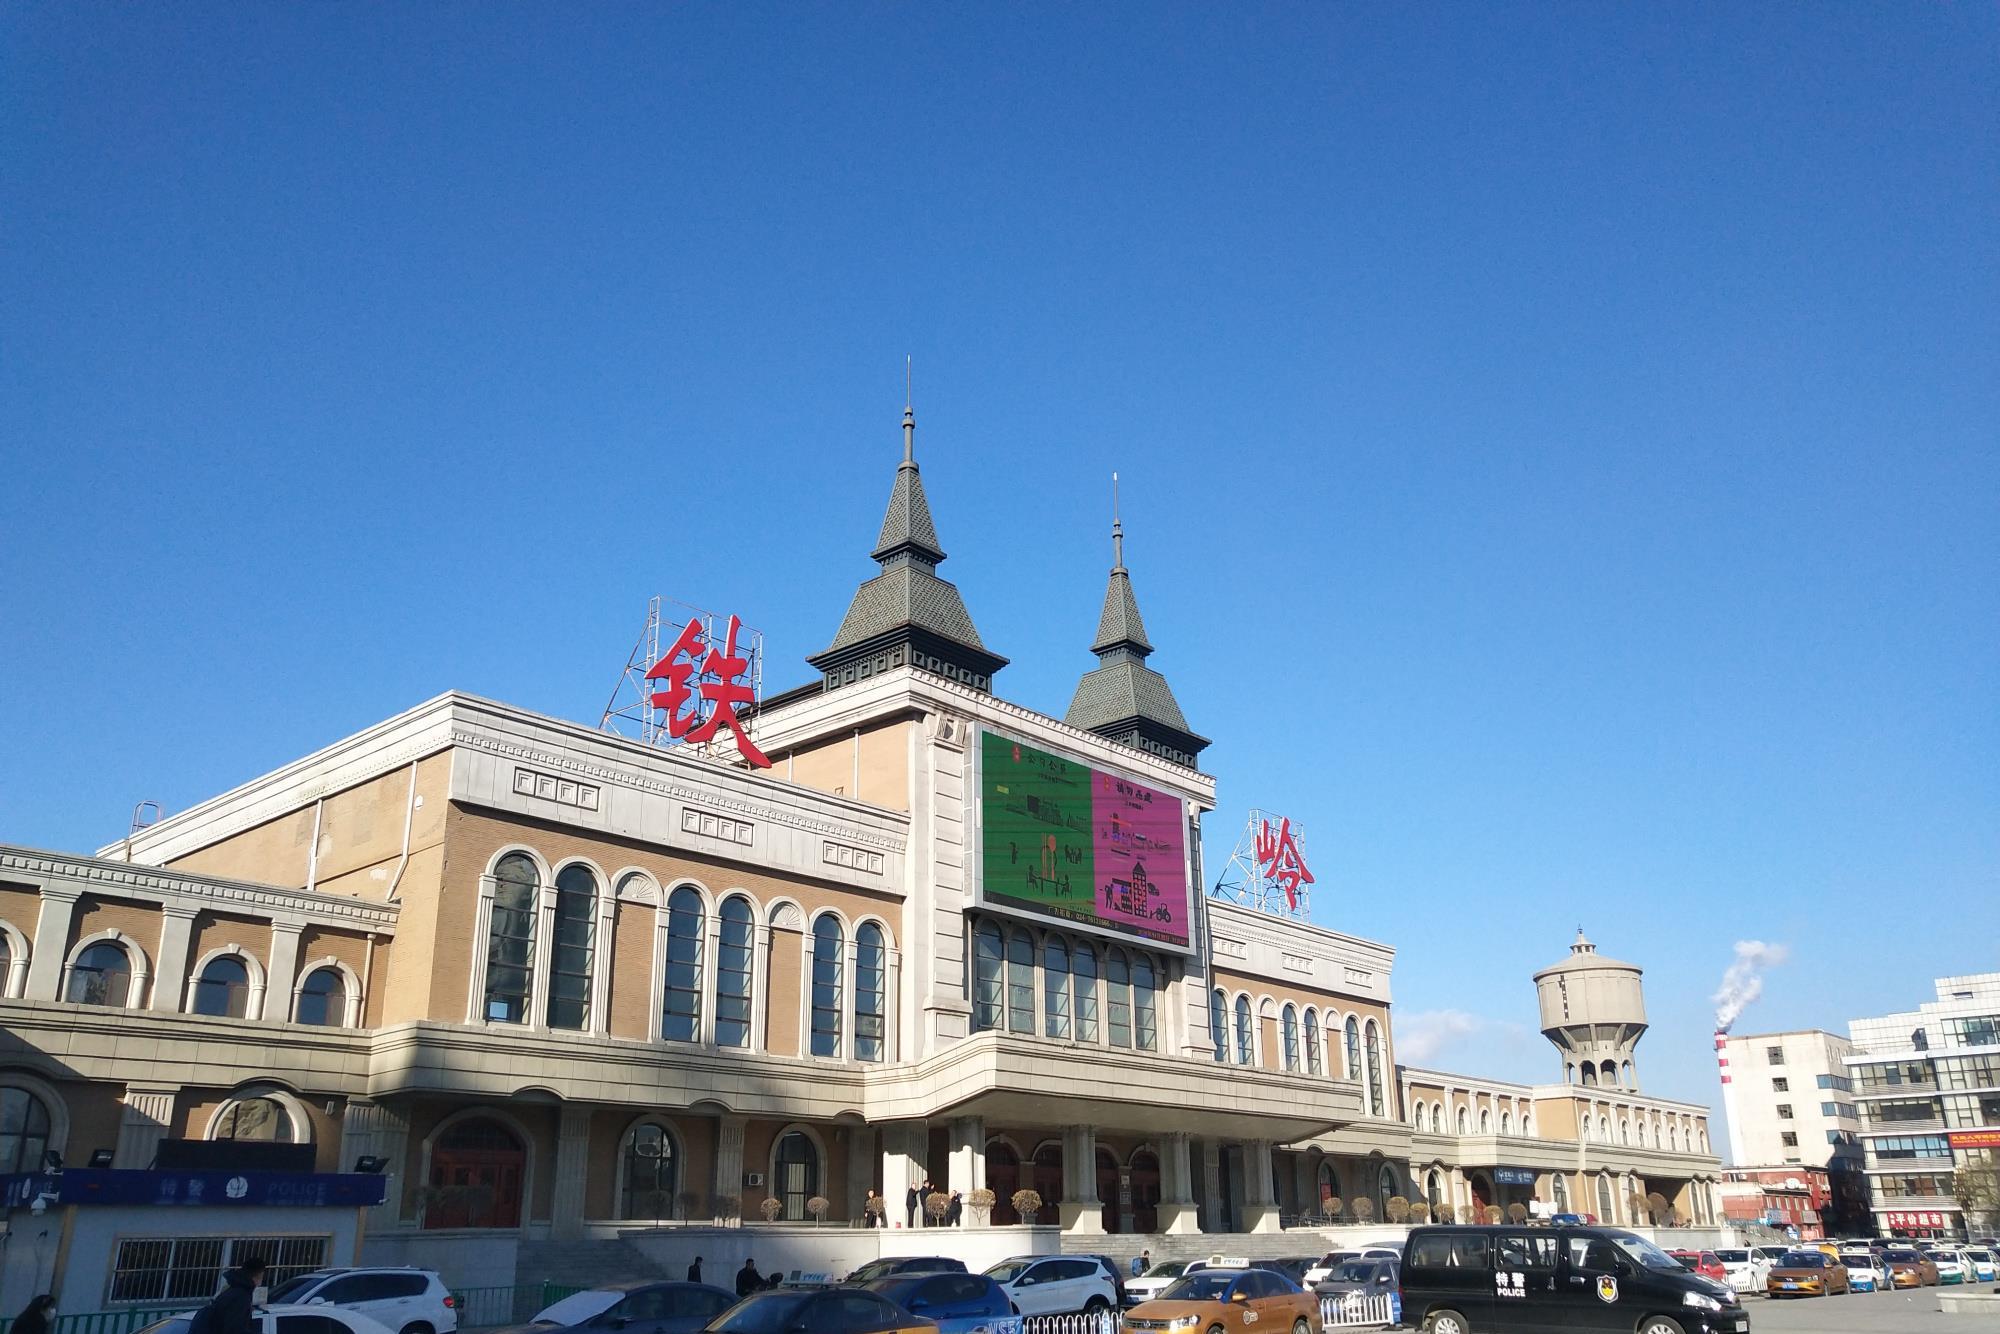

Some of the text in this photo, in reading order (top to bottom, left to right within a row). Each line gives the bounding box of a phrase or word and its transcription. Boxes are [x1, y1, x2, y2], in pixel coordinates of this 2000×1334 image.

[645, 614, 772, 768] 铁
[1255, 816, 1315, 911] 岭
[267, 1182, 328, 1196] POLICE
[1896, 1213, 1941, 1226] 平价超市
[1495, 1271, 1525, 1288] 特警
[1497, 1287, 1526, 1297] POLICE
